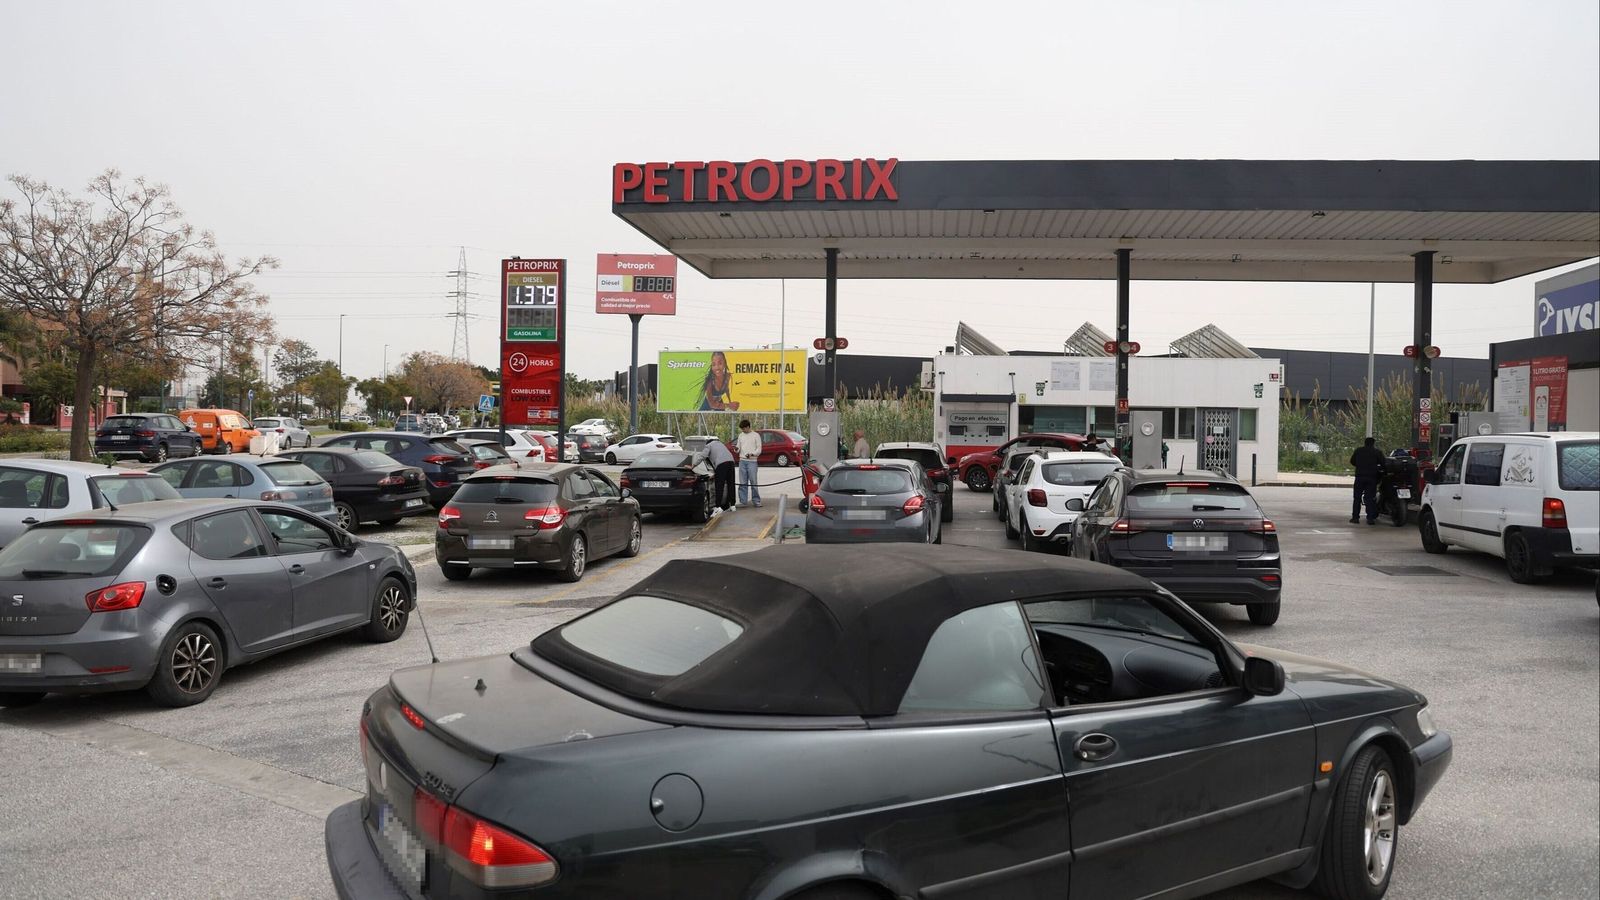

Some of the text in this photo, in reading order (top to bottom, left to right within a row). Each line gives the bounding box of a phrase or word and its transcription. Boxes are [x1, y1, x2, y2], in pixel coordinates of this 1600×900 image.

[613, 158, 898, 203] PETROPRIX
[507, 261, 559, 270] PETROPRIX
[617, 261, 655, 271] Petroprix
[515, 285, 557, 305] 1.379
[839, 340, 845, 348] 2
[512, 358, 525, 366] 24
[667, 360, 705, 369] Sprinter
[735, 363, 769, 374] REMATE
[530, 395, 552, 403] COST
